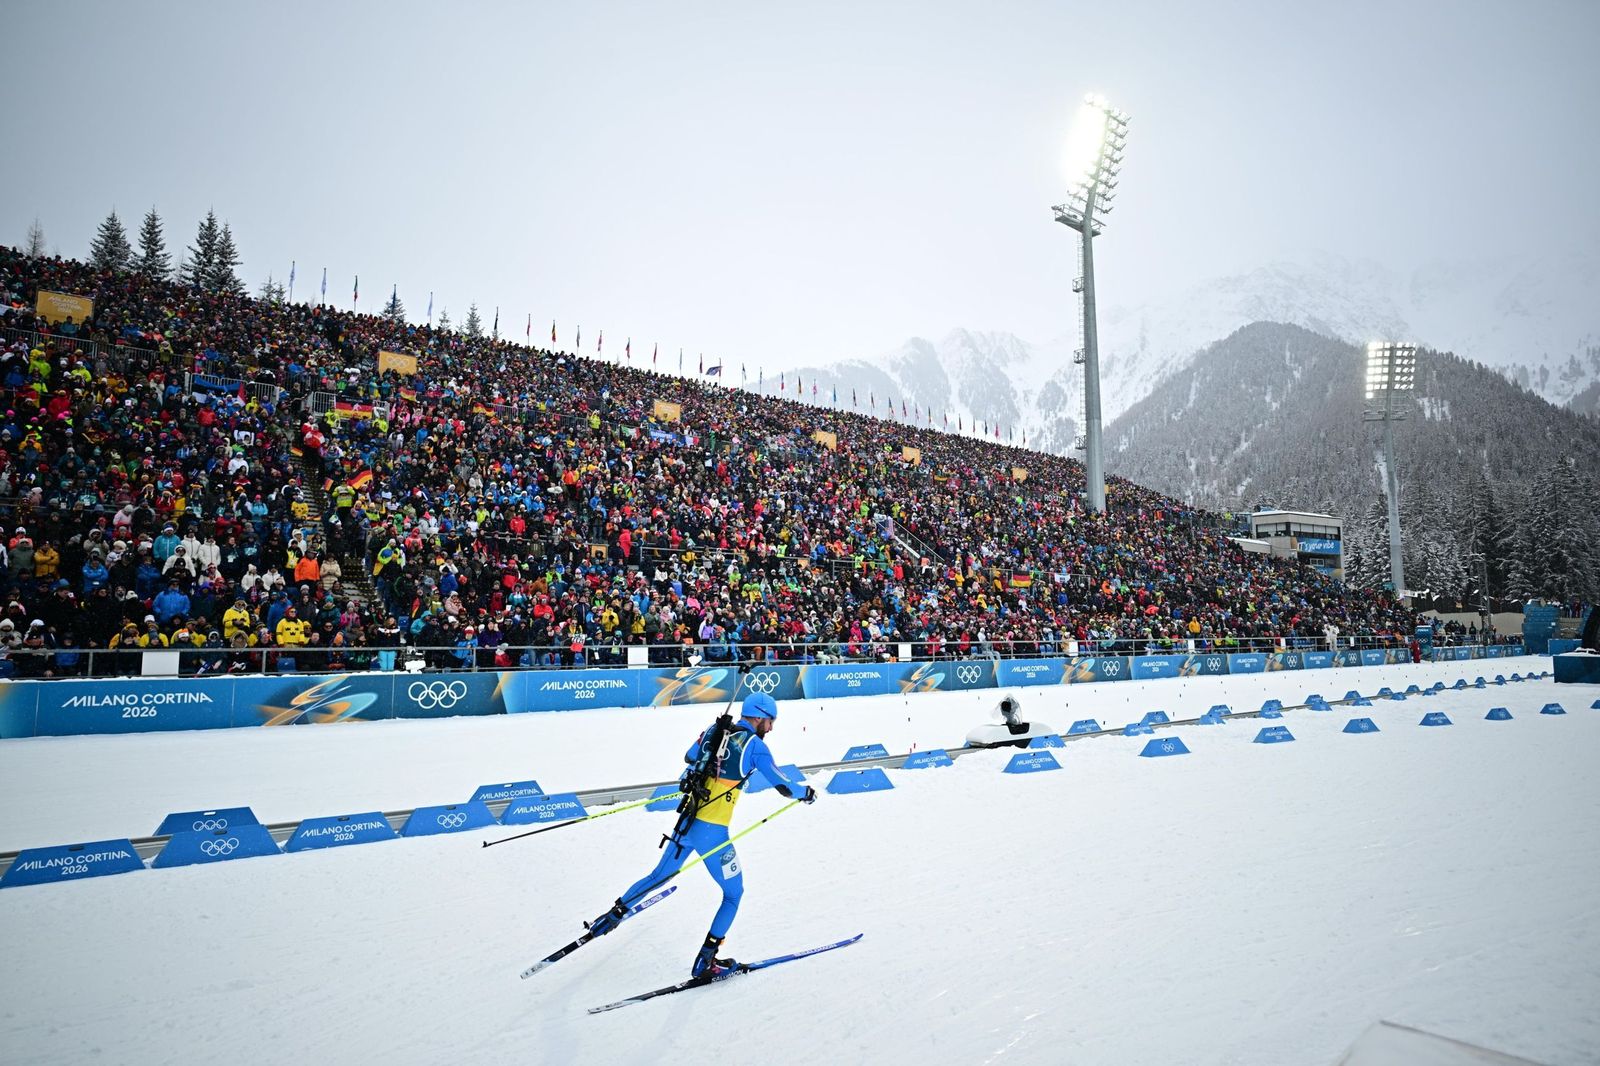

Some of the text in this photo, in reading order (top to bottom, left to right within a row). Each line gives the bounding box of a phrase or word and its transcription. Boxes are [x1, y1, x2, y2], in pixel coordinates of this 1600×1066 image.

[825, 671, 882, 681] MILANO CORTINA
[540, 679, 628, 691] MILANO CORTINA
[61, 692, 214, 708] MILANO CORTINA
[574, 690, 595, 699] 2026
[122, 706, 157, 718] 2026
[479, 790, 510, 800] MILANO
[509, 788, 541, 797] CORTINA
[726, 790, 732, 802] 6
[513, 801, 579, 815] MILANO CORTINA
[300, 821, 385, 838] MILANO CORTINA
[334, 832, 354, 842] 2026
[16, 850, 131, 872] MILANO CORTINA
[730, 862, 737, 872] 6
[61, 864, 89, 875] 2026
